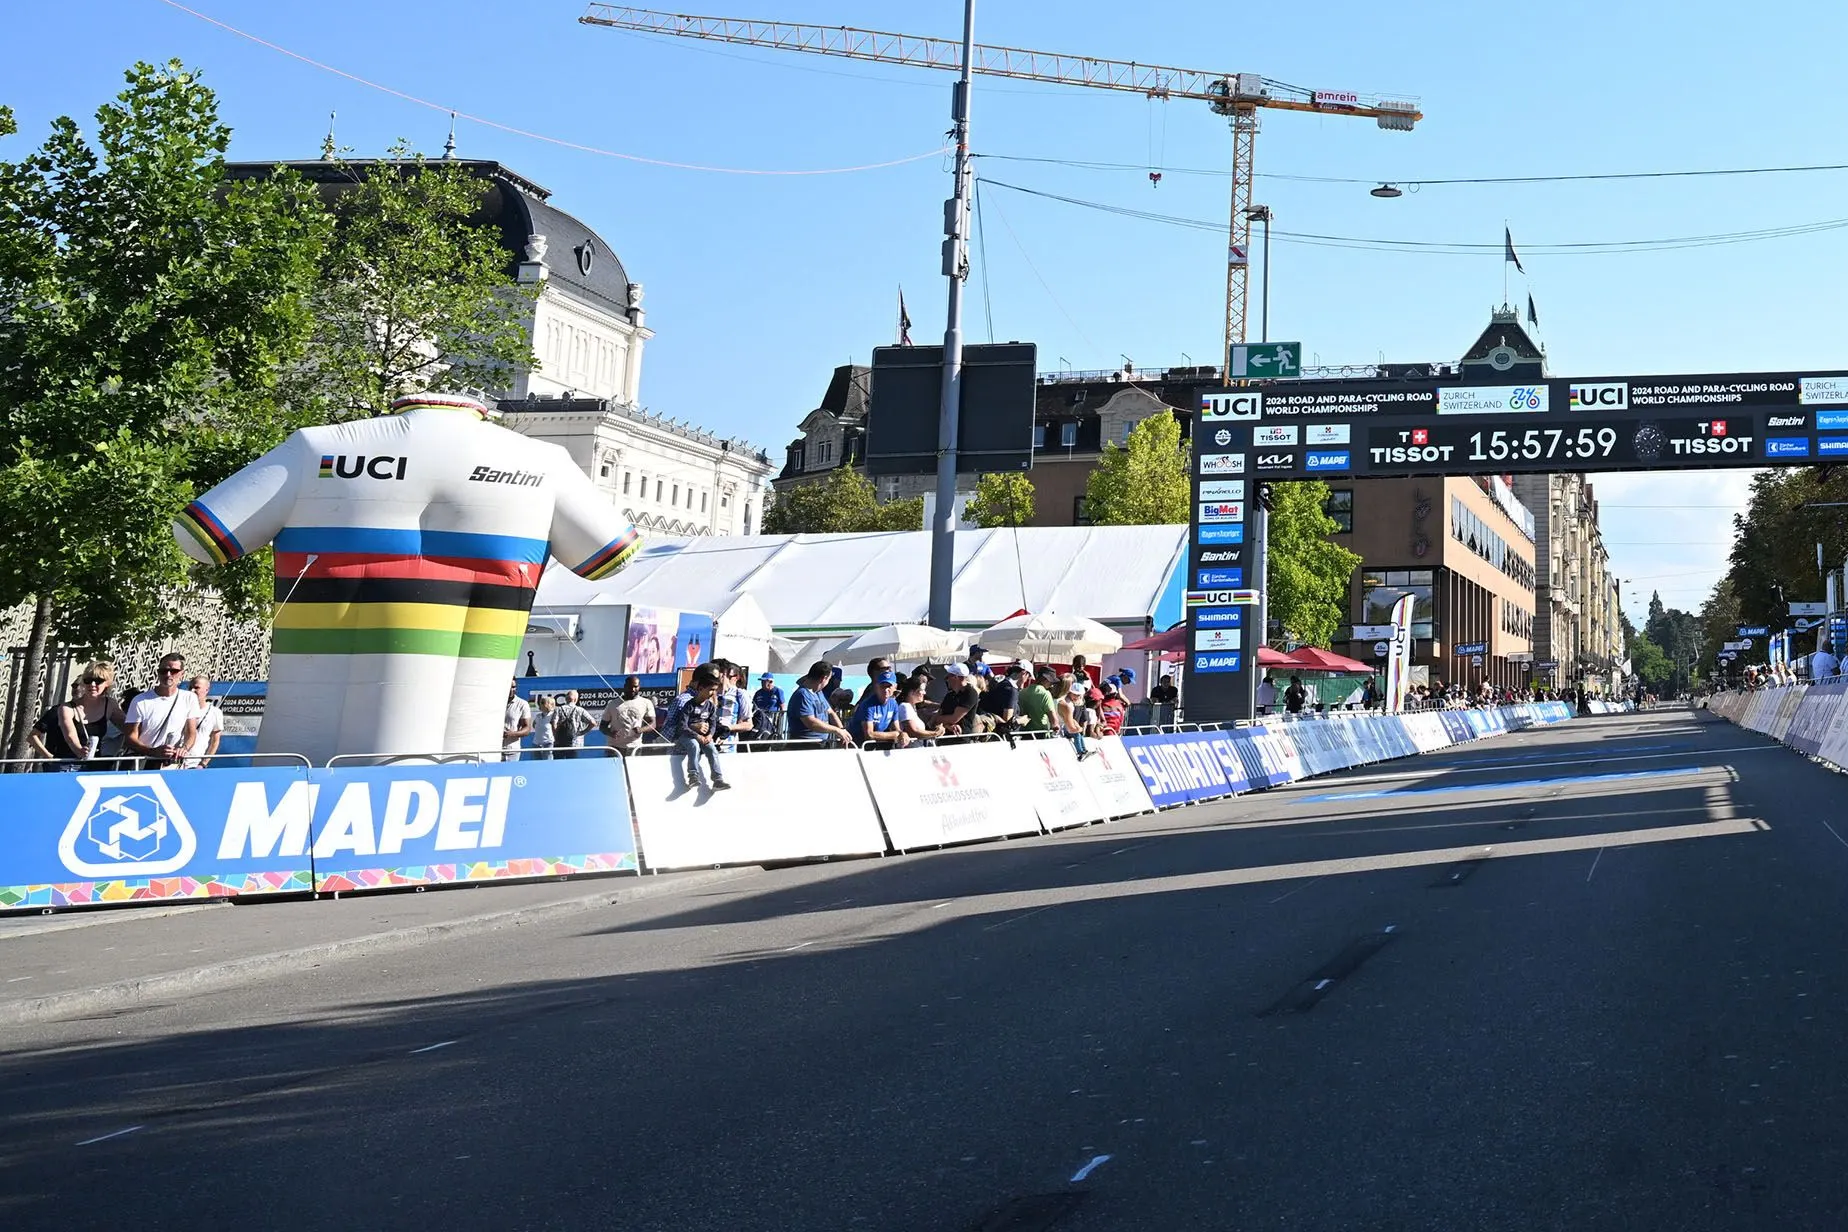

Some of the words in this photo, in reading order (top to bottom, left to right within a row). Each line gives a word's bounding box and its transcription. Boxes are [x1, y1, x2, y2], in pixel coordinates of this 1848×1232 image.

[1317, 92, 1357, 102] amrein
[1632, 387, 1652, 395] 2024
[1654, 386, 1679, 395] ROAD
[1681, 385, 1701, 394] AND
[1703, 384, 1768, 394] PARA-CYCLING
[1769, 382, 1795, 392] ROAD
[1805, 381, 1837, 391] ZURICH
[1265, 396, 1287, 405] 2024
[1288, 395, 1314, 405] ROAD
[1315, 395, 1337, 404] AND
[1338, 393, 1405, 404] PARA-CYCLING
[1406, 392, 1433, 402] ROAD
[1443, 391, 1475, 400] ZURICH
[1579, 387, 1624, 406] UCI
[1632, 395, 1666, 405] WORLD
[1667, 393, 1743, 404] CHAMPIONSHIPS
[1212, 397, 1257, 417] UCI
[1265, 405, 1300, 415] WORLD
[1301, 403, 1379, 414] CHAMPIONSHIPS
[1443, 400, 1503, 410] SWITZERLAND
[1767, 415, 1806, 427] Santini
[1260, 434, 1291, 442] TISSOT
[1468, 427, 1617, 461] 15:57:59
[1670, 436, 1753, 455] TISSOT
[1320, 455, 1348, 465] MAPEI
[1370, 445, 1455, 463] TISSOT
[335, 455, 408, 480] UCI
[468, 465, 546, 488] Santini
[1204, 505, 1239, 516] BigMat
[1200, 550, 1241, 562] Santini
[1206, 592, 1232, 603] UCI
[1198, 613, 1239, 621] SHIMANO
[1209, 657, 1238, 667] MAPEI
[1130, 740, 1226, 796] SHIMANO
